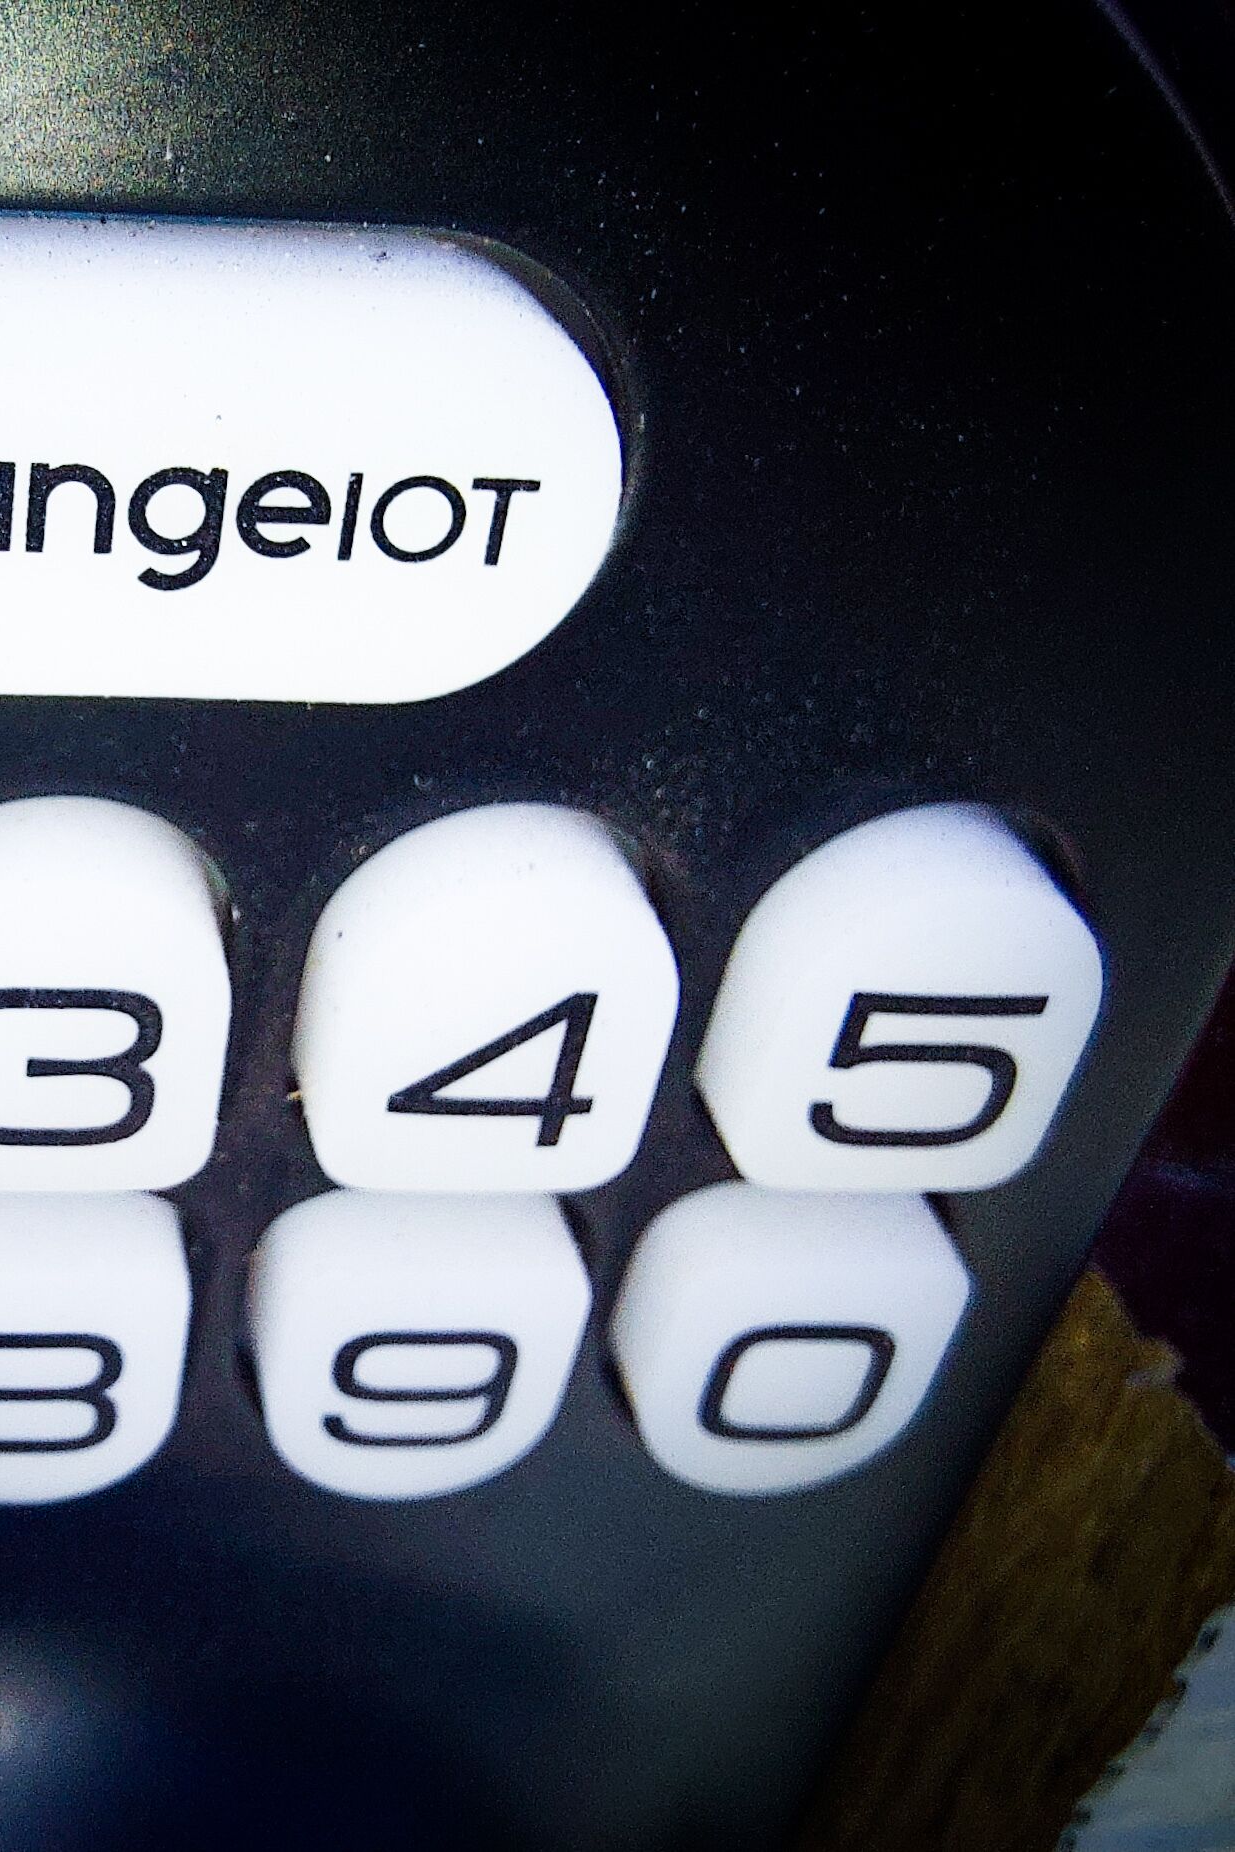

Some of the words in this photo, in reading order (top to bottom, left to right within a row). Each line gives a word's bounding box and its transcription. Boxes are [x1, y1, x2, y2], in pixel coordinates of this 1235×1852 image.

[386, 992, 599, 1147] 4
[808, 991, 1050, 1148] 5
[322, 1330, 519, 1448] 9
[696, 1324, 897, 1445] 0
